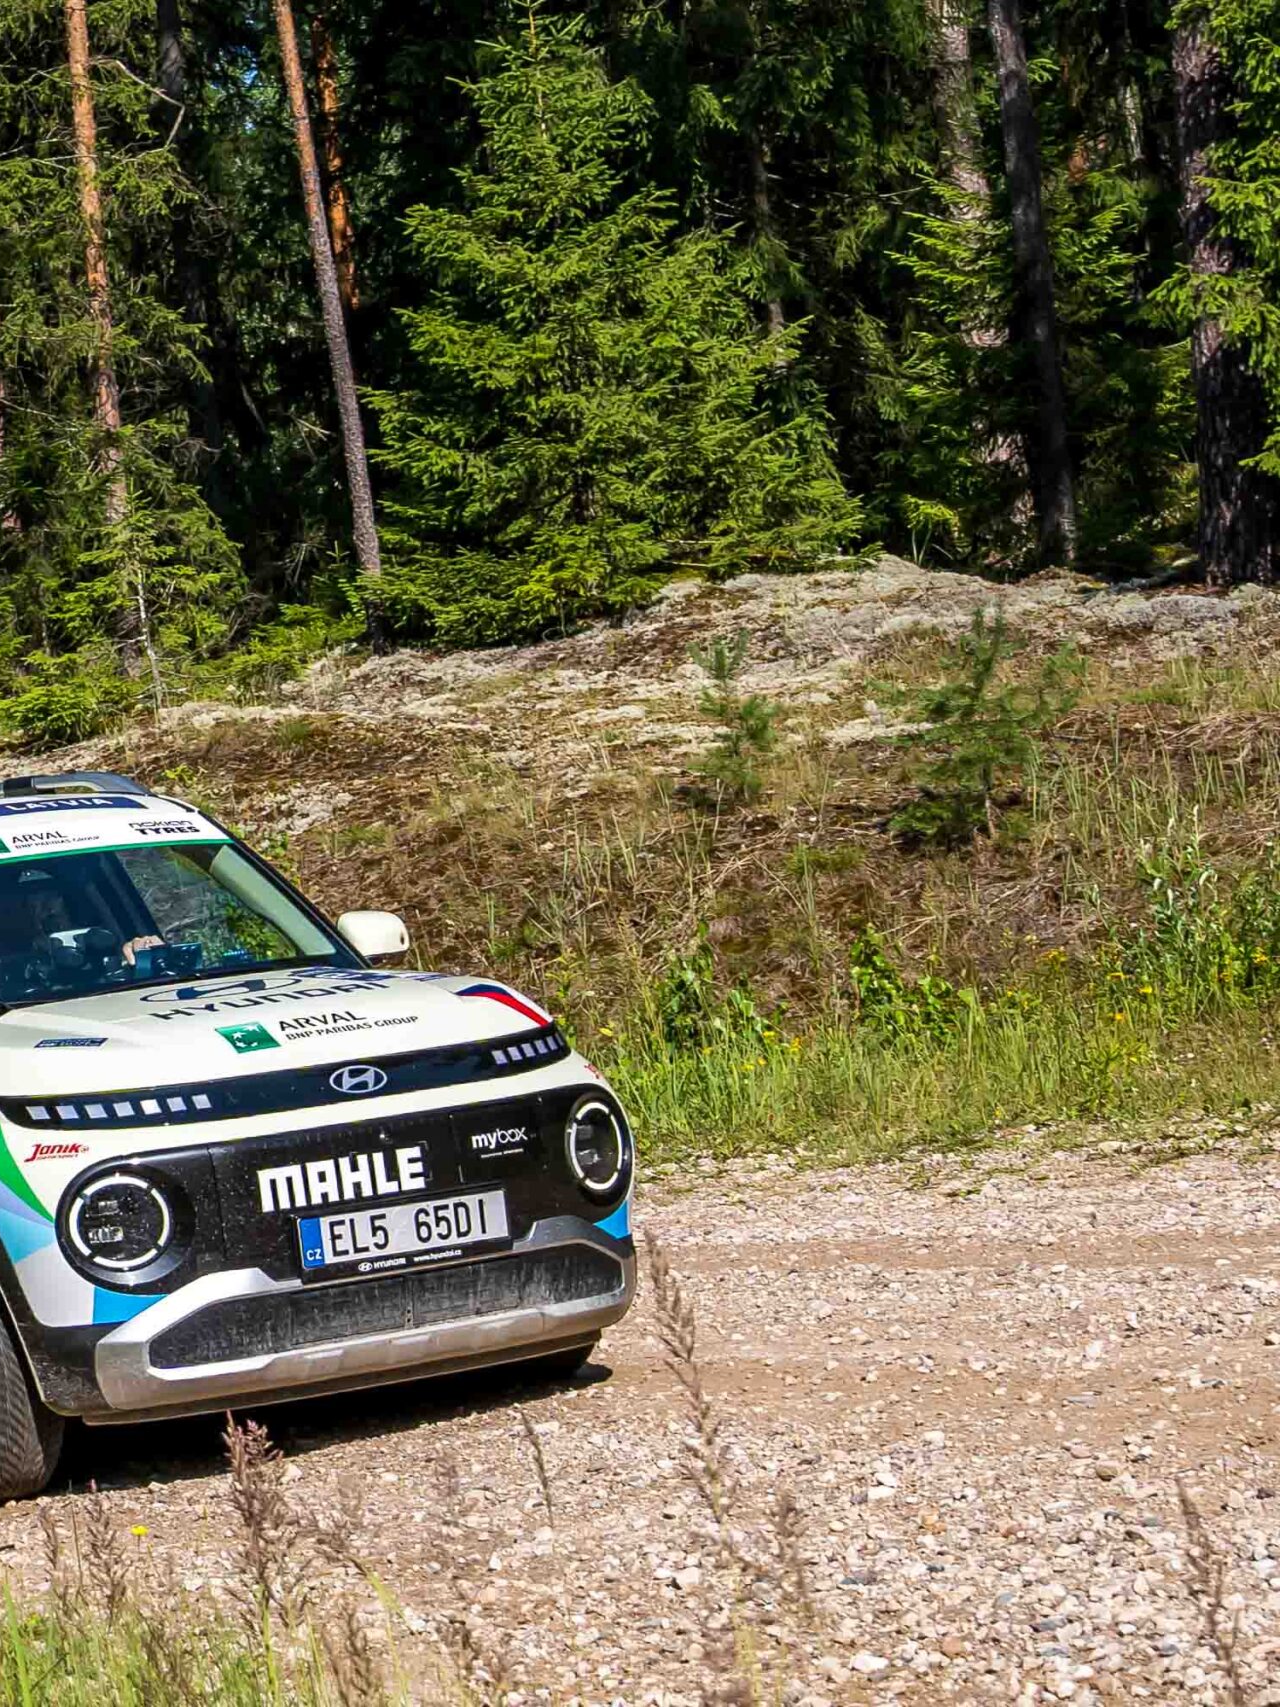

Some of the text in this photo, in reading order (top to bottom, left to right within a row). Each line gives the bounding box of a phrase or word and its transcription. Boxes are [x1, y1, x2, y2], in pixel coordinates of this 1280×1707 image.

[5, 798, 114, 811] LATVIA
[12, 830, 68, 844] ARVAL
[134, 826, 201, 835] TYRES
[150, 981, 390, 1020] HYUNDAI
[279, 1011, 368, 1031] ARVAL
[285, 1015, 419, 1041] BNP PARIBAS GROUP
[471, 1126, 529, 1150] mybox
[24, 1143, 82, 1163] Janik
[257, 1146, 426, 1213] MAHLE
[328, 1198, 488, 1257] EL5 65DI
[306, 1248, 323, 1261] CZ
[373, 1256, 407, 1269] HYUNDAI
